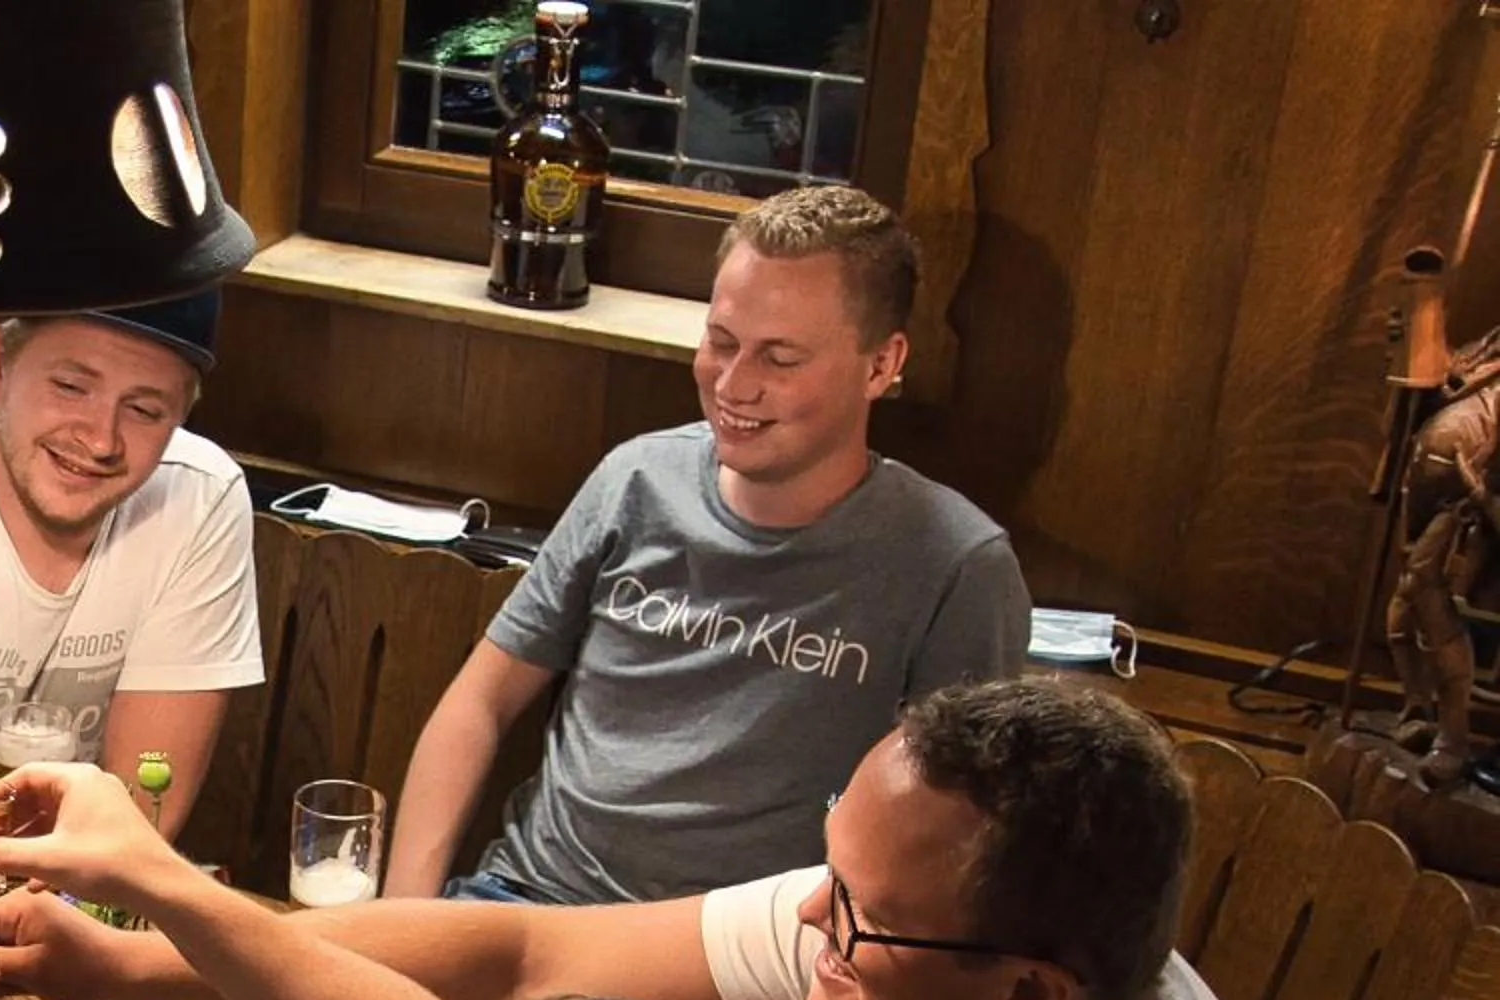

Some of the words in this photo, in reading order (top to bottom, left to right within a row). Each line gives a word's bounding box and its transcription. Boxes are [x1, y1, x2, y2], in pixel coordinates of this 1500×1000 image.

[59, 629, 126, 659] GOODS
[608, 576, 746, 655] Calvin
[746, 613, 869, 684] Klein
